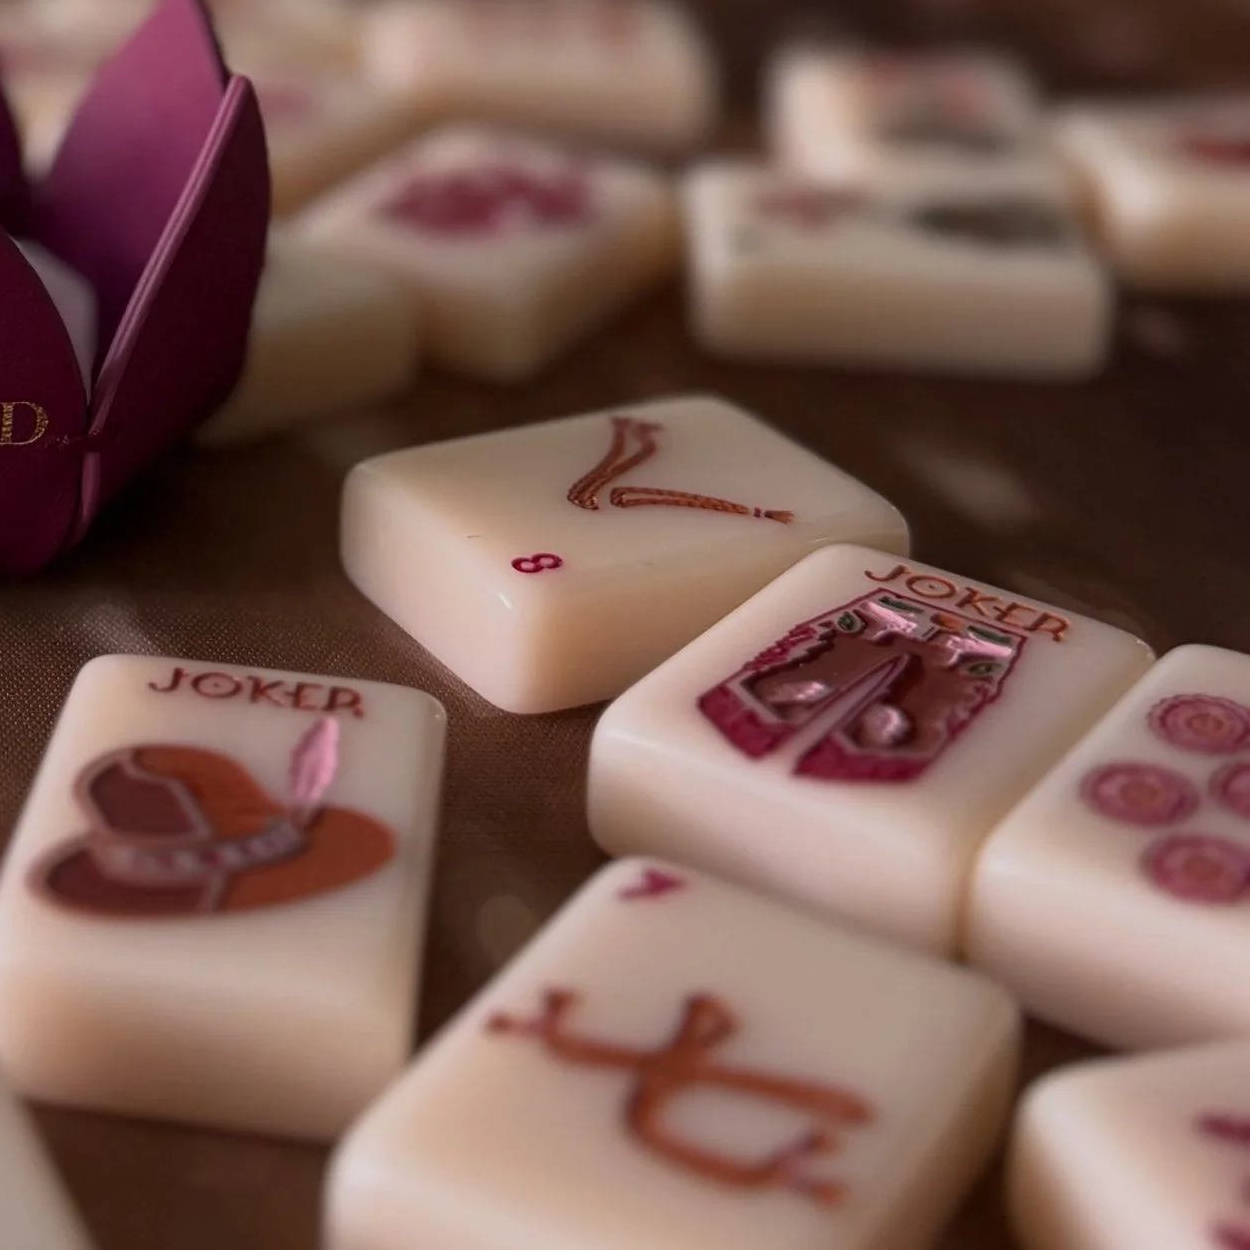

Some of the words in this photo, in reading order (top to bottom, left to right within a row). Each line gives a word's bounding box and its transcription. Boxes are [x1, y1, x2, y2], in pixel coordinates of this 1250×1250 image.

[511, 553, 563, 573] 8
[864, 565, 1071, 642] JOKER
[148, 667, 365, 718] JOKER
